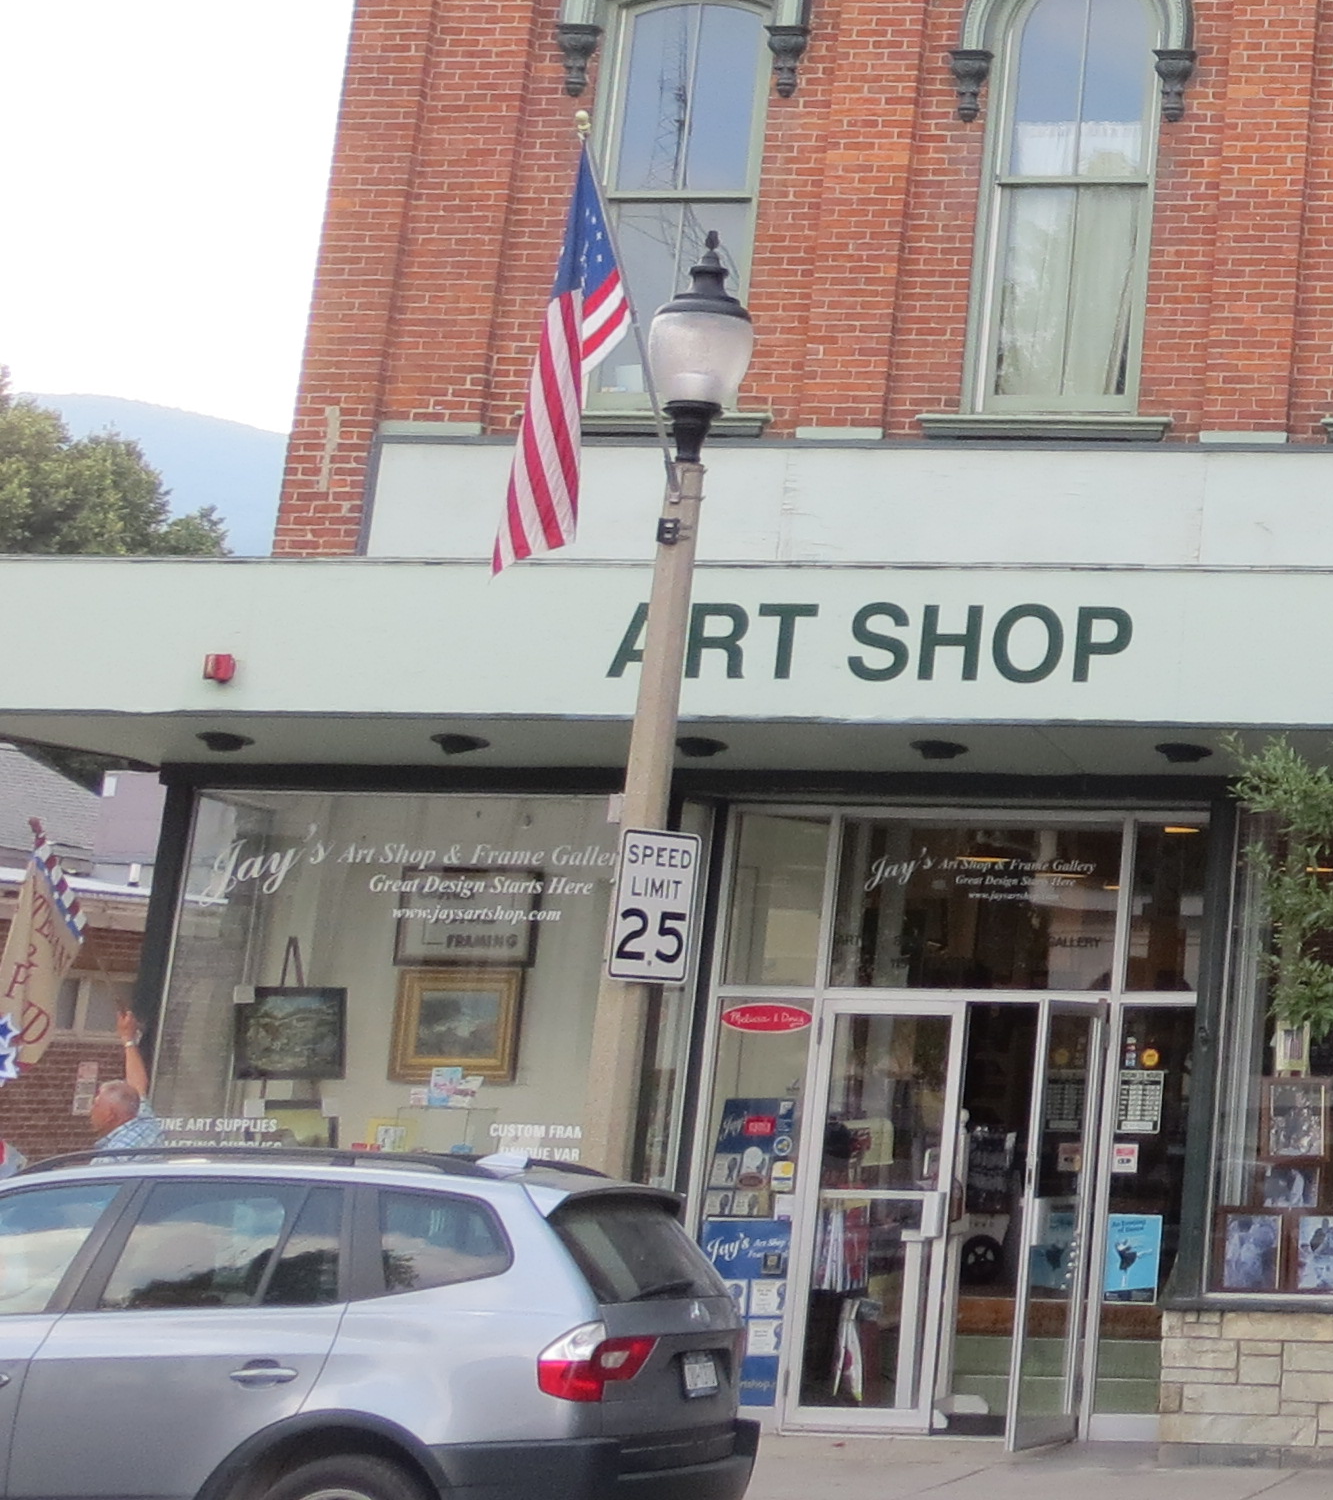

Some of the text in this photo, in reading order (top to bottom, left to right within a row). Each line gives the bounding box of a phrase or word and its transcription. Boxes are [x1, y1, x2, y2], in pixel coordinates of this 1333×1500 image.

[846, 601, 1135, 684] SHOP
[200, 823, 619, 907] Jay's Art Shop & Frame Galler
[627, 844, 693, 869] SPEED
[864, 847, 938, 891] Jay's
[959, 858, 991, 873] Shop
[1010, 858, 1049, 871] Frame
[1052, 858, 1097, 875] Gallery
[369, 874, 421, 893] Great
[423, 875, 486, 898] Design
[490, 876, 545, 895] Starts
[547, 877, 594, 896] Here
[631, 875, 683, 900] LIMIT
[985, 875, 1018, 889] Design
[392, 904, 562, 925] www.jaysartshop.com
[615, 907, 688, 964] 25
[185, 1117, 213, 1132] ART
[214, 1118, 278, 1133] SUPPLIES
[489, 1123, 545, 1138] CUSTOM
[554, 1147, 580, 1161] VAR
[707, 1232, 750, 1263] Jay's
